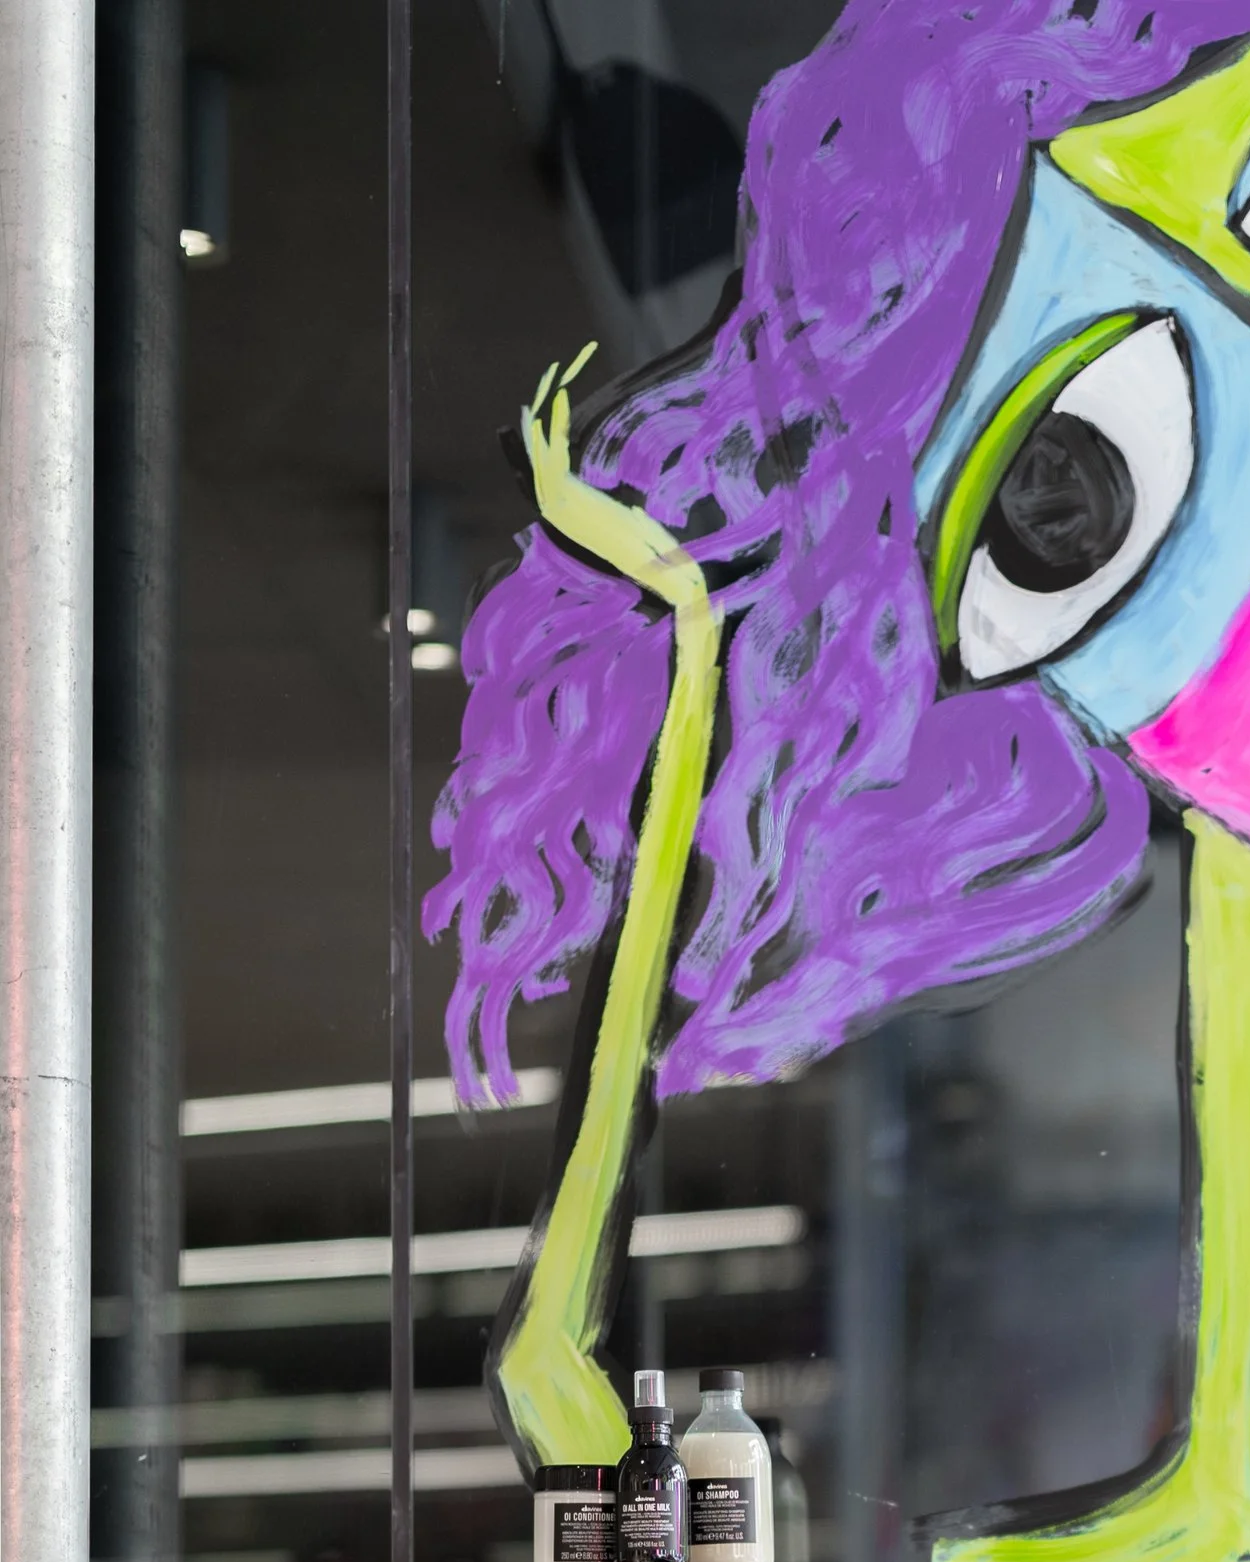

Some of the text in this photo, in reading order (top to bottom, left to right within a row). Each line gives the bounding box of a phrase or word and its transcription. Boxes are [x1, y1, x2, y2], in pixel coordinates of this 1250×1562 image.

[697, 1490, 739, 1500] OI SHAMPOO
[628, 1504, 637, 1512] ALL
[644, 1503, 656, 1511] ONE
[657, 1503, 670, 1511] MILK
[564, 1513, 572, 1521] OI
[573, 1513, 616, 1521] CONDITIONE
